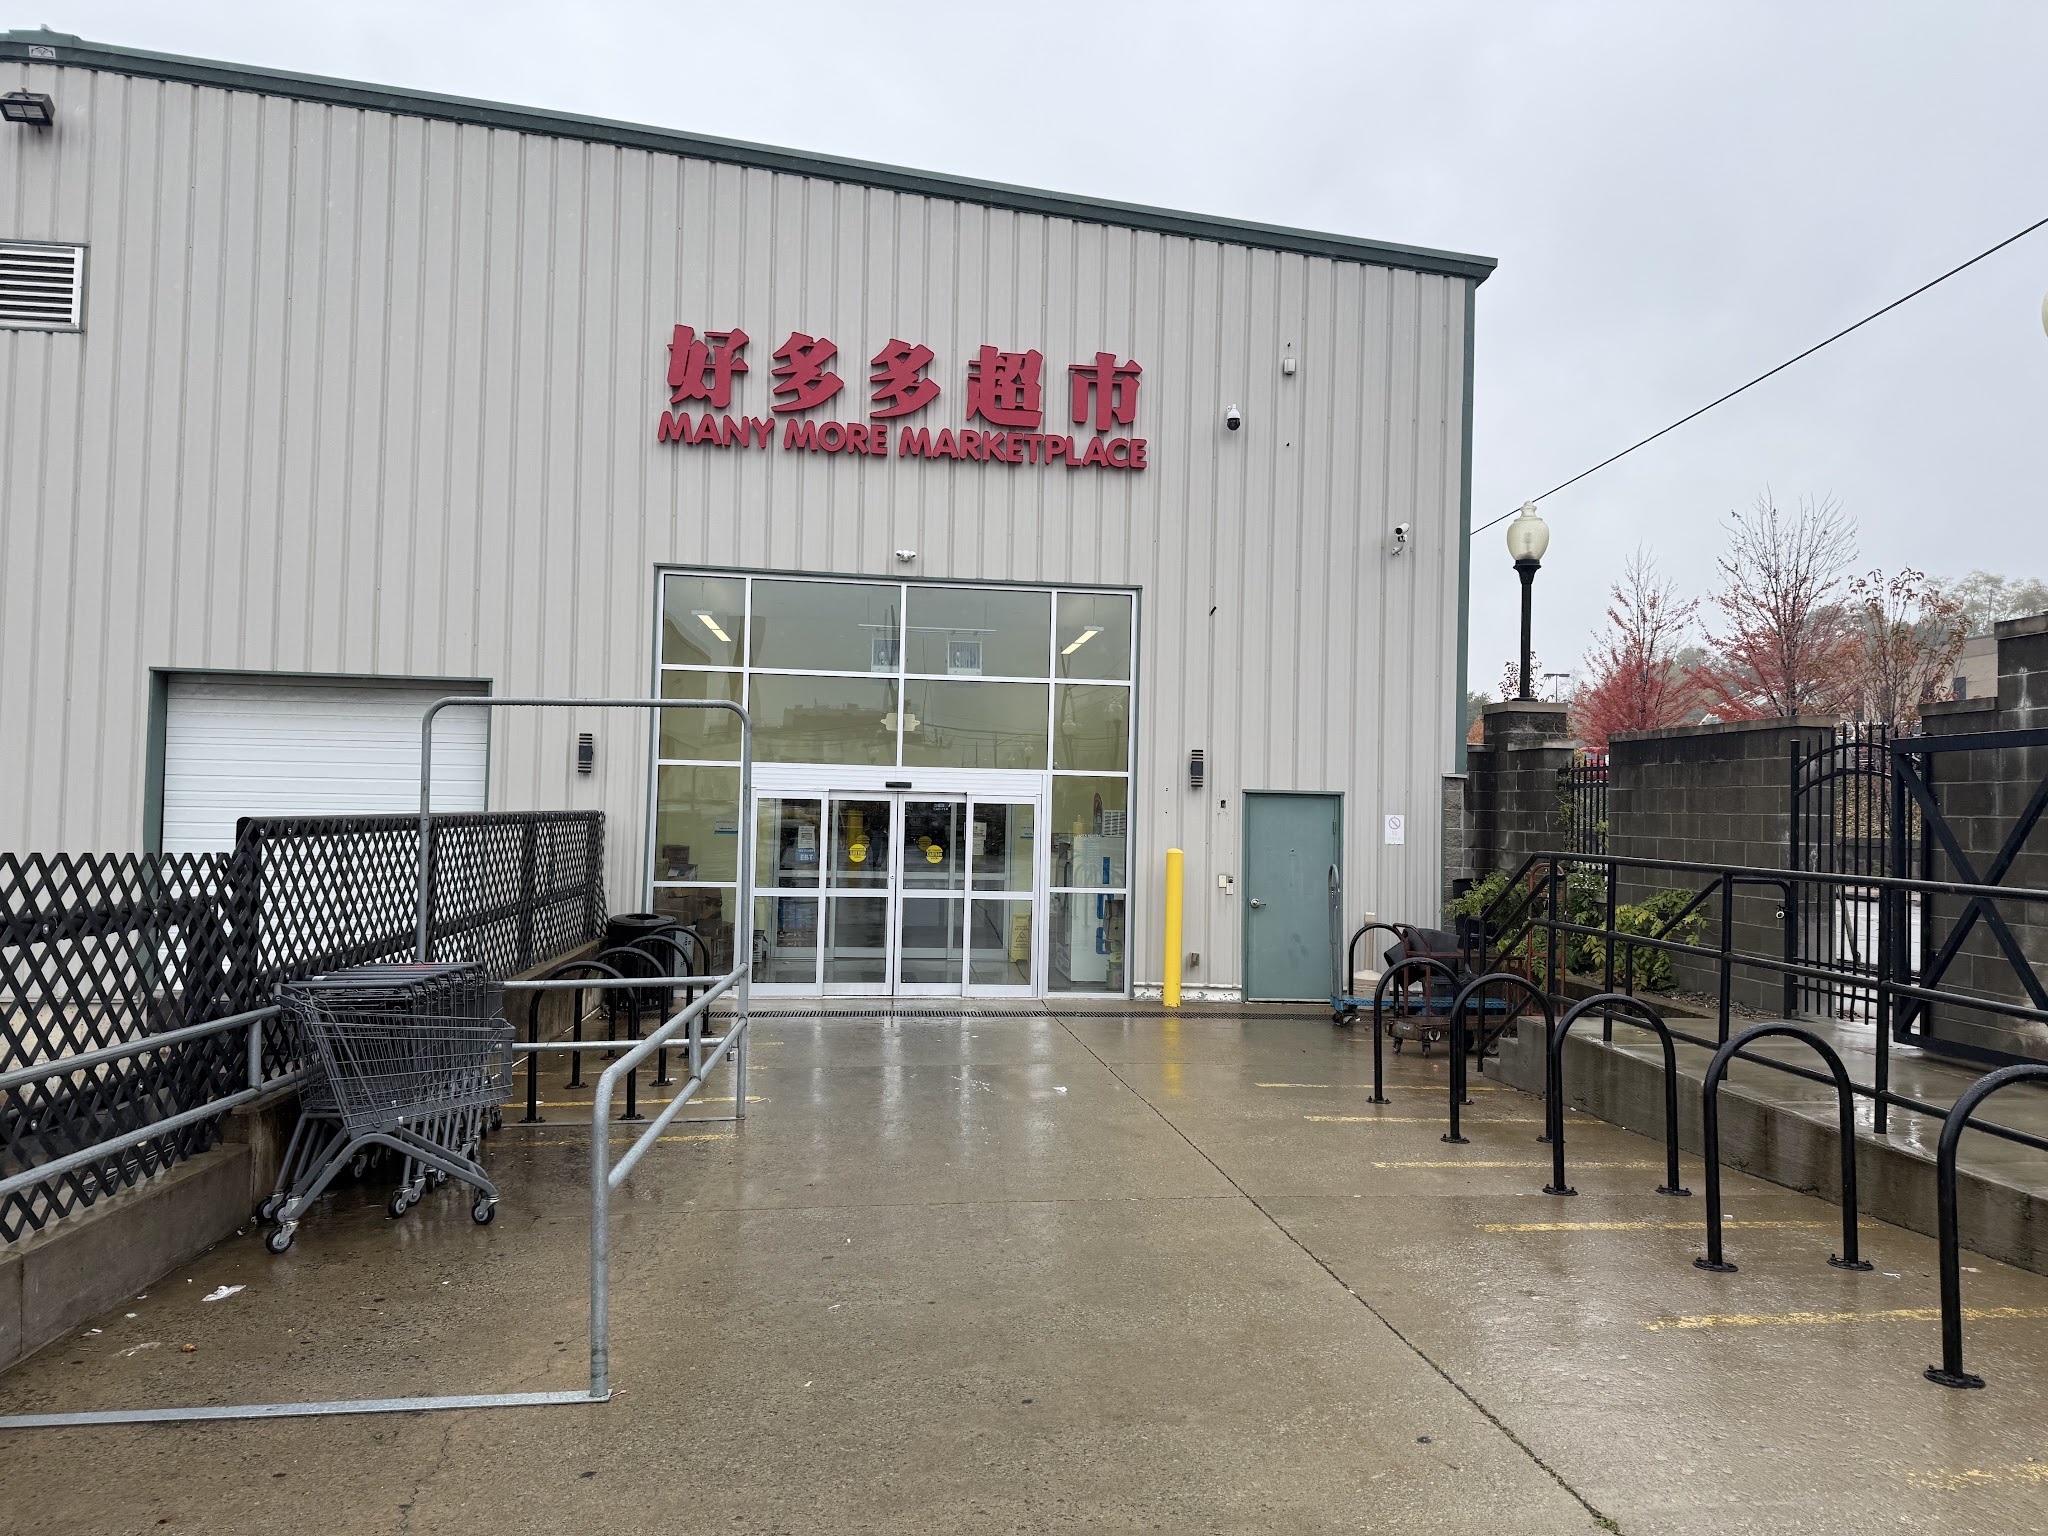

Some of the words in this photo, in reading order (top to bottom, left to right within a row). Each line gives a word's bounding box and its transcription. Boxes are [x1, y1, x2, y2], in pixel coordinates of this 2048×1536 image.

[666, 324, 1143, 432] 好多多超市
[657, 410, 777, 449] MANY
[783, 418, 889, 456] MORE
[898, 425, 1148, 469] MARKETPLACE
[800, 853, 814, 861] EBT
